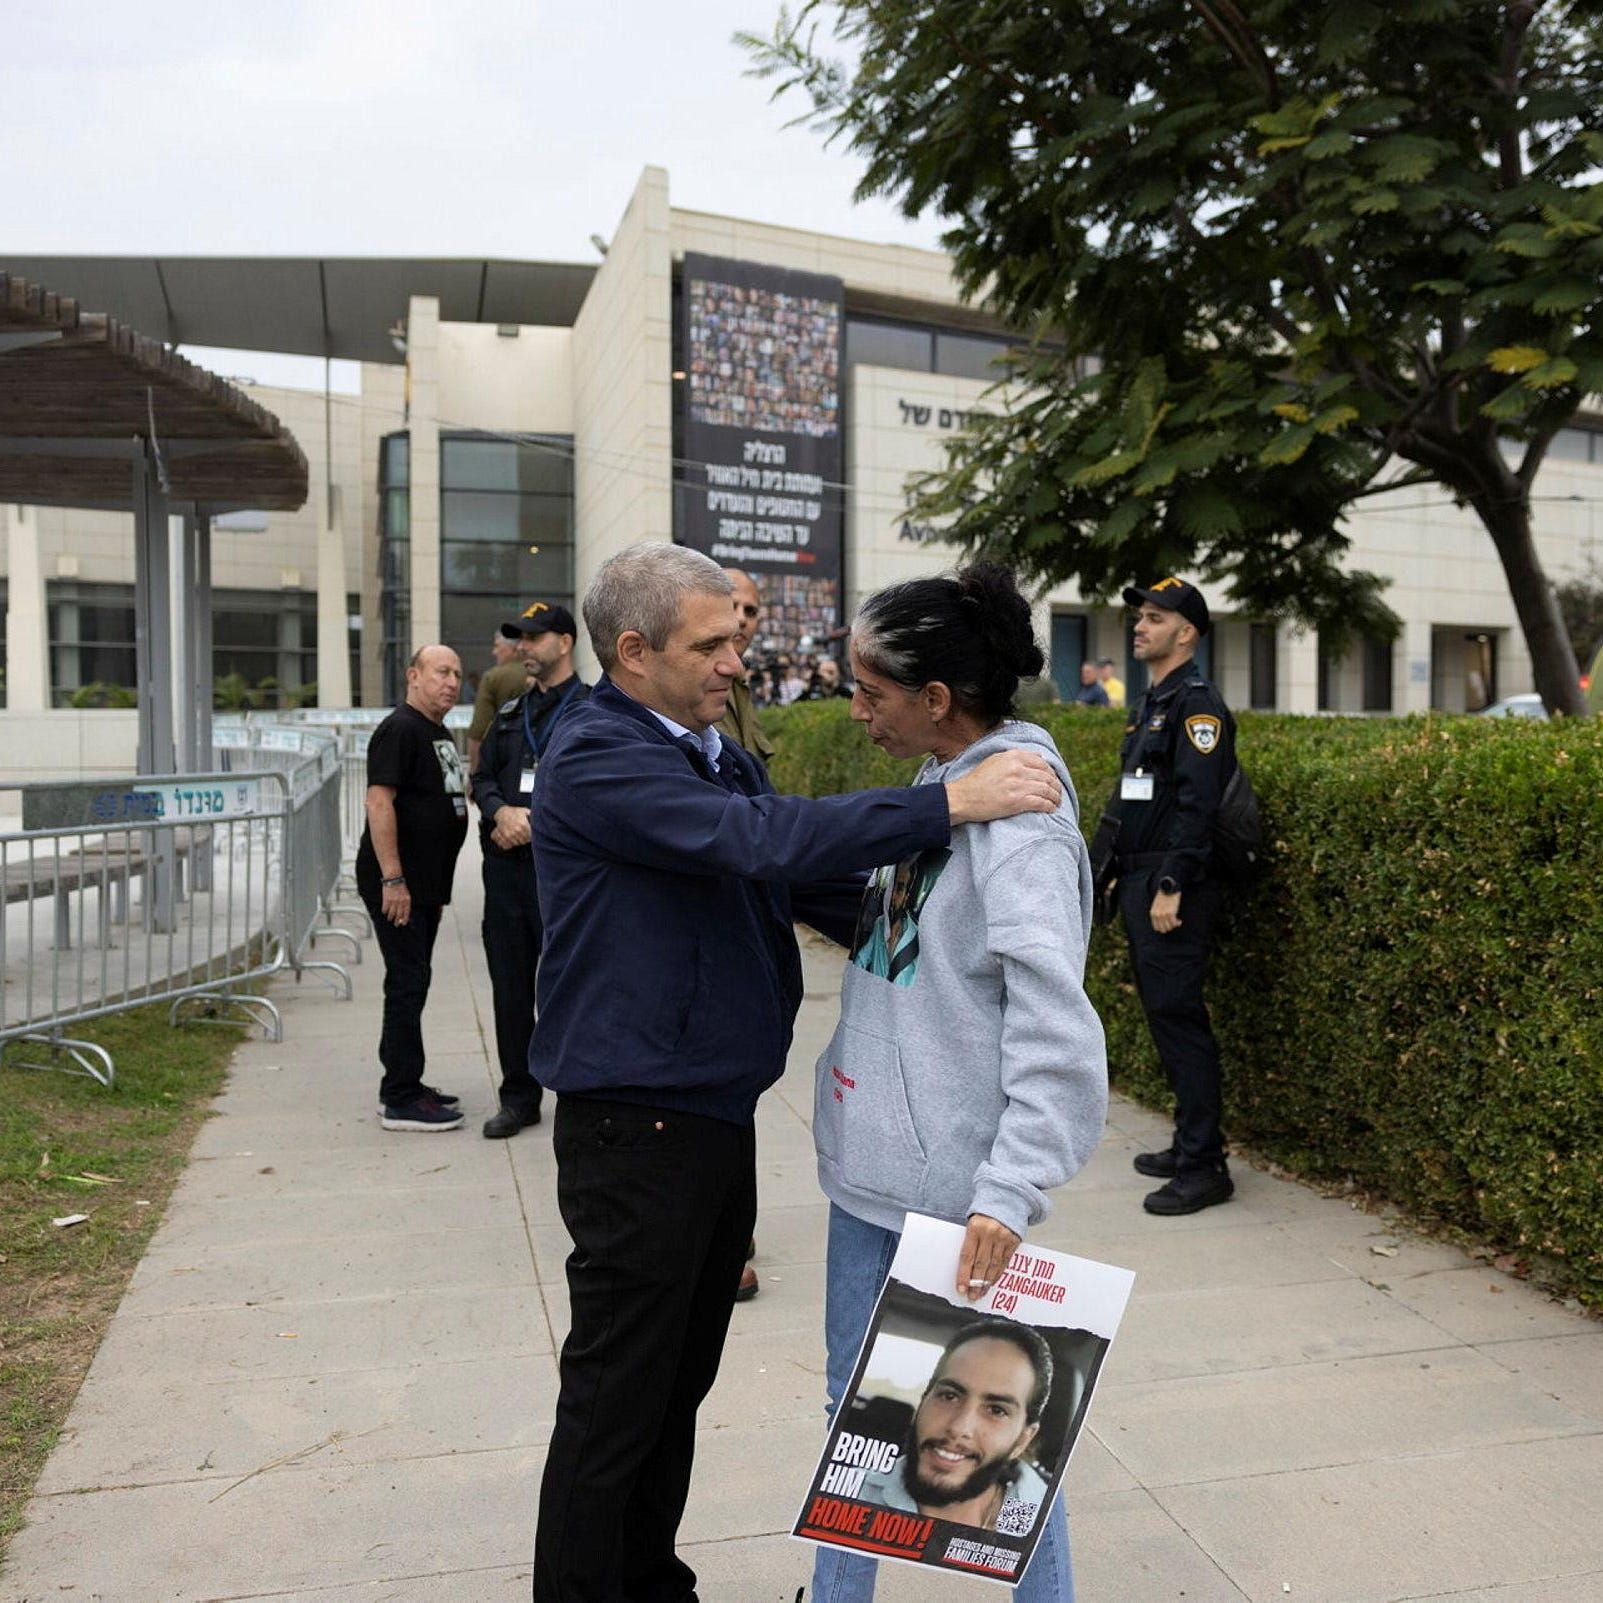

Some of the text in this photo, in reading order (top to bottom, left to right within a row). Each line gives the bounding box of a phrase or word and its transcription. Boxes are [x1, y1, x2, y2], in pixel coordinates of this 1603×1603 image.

[899, 397, 931, 426] של
[1007, 1253, 1055, 1280] מתן צנג
[991, 1291, 1018, 1314] (24)
[998, 1272, 1066, 1304] ZANGAUKER
[832, 1432, 899, 1473] BRING
[820, 1463, 866, 1499] HIM
[808, 1497, 935, 1549] HOME NOW!
[943, 1546, 1018, 1573] FAMILIES FORUM
[949, 1537, 1022, 1560] HOSTAGES AND MISSING
